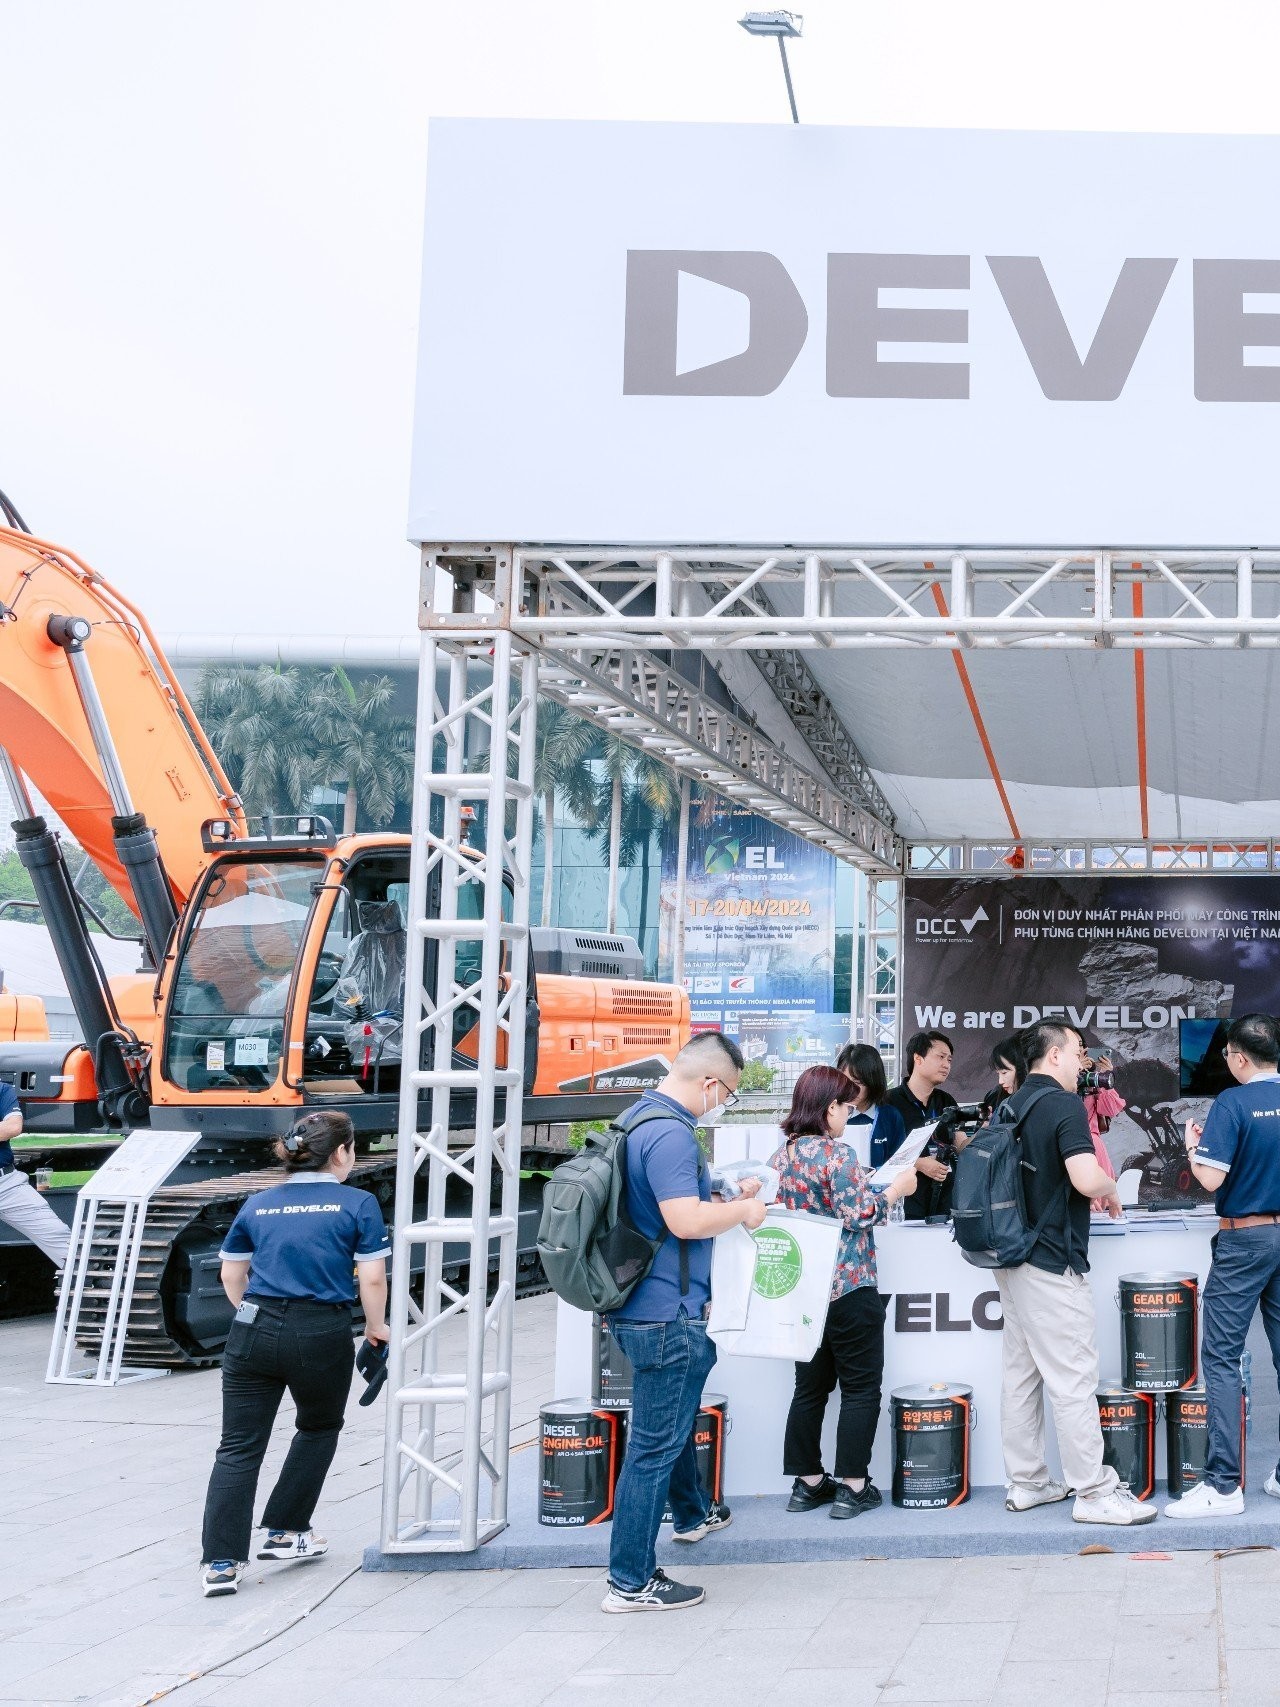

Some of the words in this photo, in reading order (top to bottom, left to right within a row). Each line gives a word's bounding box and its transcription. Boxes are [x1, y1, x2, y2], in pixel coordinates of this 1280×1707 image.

[745, 846, 784, 869] EL
[724, 873, 767, 881] Vietnam
[770, 873, 796, 881] 2024
[687, 899, 812, 917] 17-20/04/2024
[1014, 909, 1040, 921] ĐƠN
[1042, 909, 1055, 923] VỊ
[1058, 909, 1082, 921] DUY
[1085, 906, 1117, 921] NHẤT
[1120, 907, 1153, 921] PHÂN
[1217, 908, 1248, 921] CÔNG
[916, 918, 957, 935] DCC
[1014, 927, 1039, 941] PHỤ
[1042, 925, 1074, 938] TÙNG
[1077, 925, 1113, 938] CHÍNH
[1116, 925, 1150, 938] HÃNG
[1153, 927, 1207, 939] DEVELON
[1210, 927, 1229, 941] TẠI
[1232, 925, 1257, 941] VIỆT
[914, 1005, 957, 1029] We
[963, 1010, 1006, 1029] are
[1252, 1110, 1263, 1118] We
[255, 1208, 267, 1216] We
[283, 1204, 341, 1214] DEVELON
[1133, 1293, 1164, 1305] GEAR
[1165, 1292, 1184, 1304] OIL
[879, 1290, 1005, 1333] ELO
[1135, 1379, 1179, 1388] DEVELON
[600, 1398, 633, 1406] DEVEL
[903, 1410, 952, 1423] 유압작동유
[1098, 1406, 1116, 1418] AR
[1118, 1405, 1136, 1417] OIL
[543, 1423, 580, 1437] DIESEL
[542, 1437, 583, 1450] ENGINE
[585, 1435, 605, 1448] OIL
[695, 1431, 713, 1444] OIL
[903, 1460, 915, 1468] 20L
[1182, 1462, 1194, 1470] 20L
[902, 1498, 948, 1507] DEVELON
[541, 1515, 585, 1524] DEVELON
